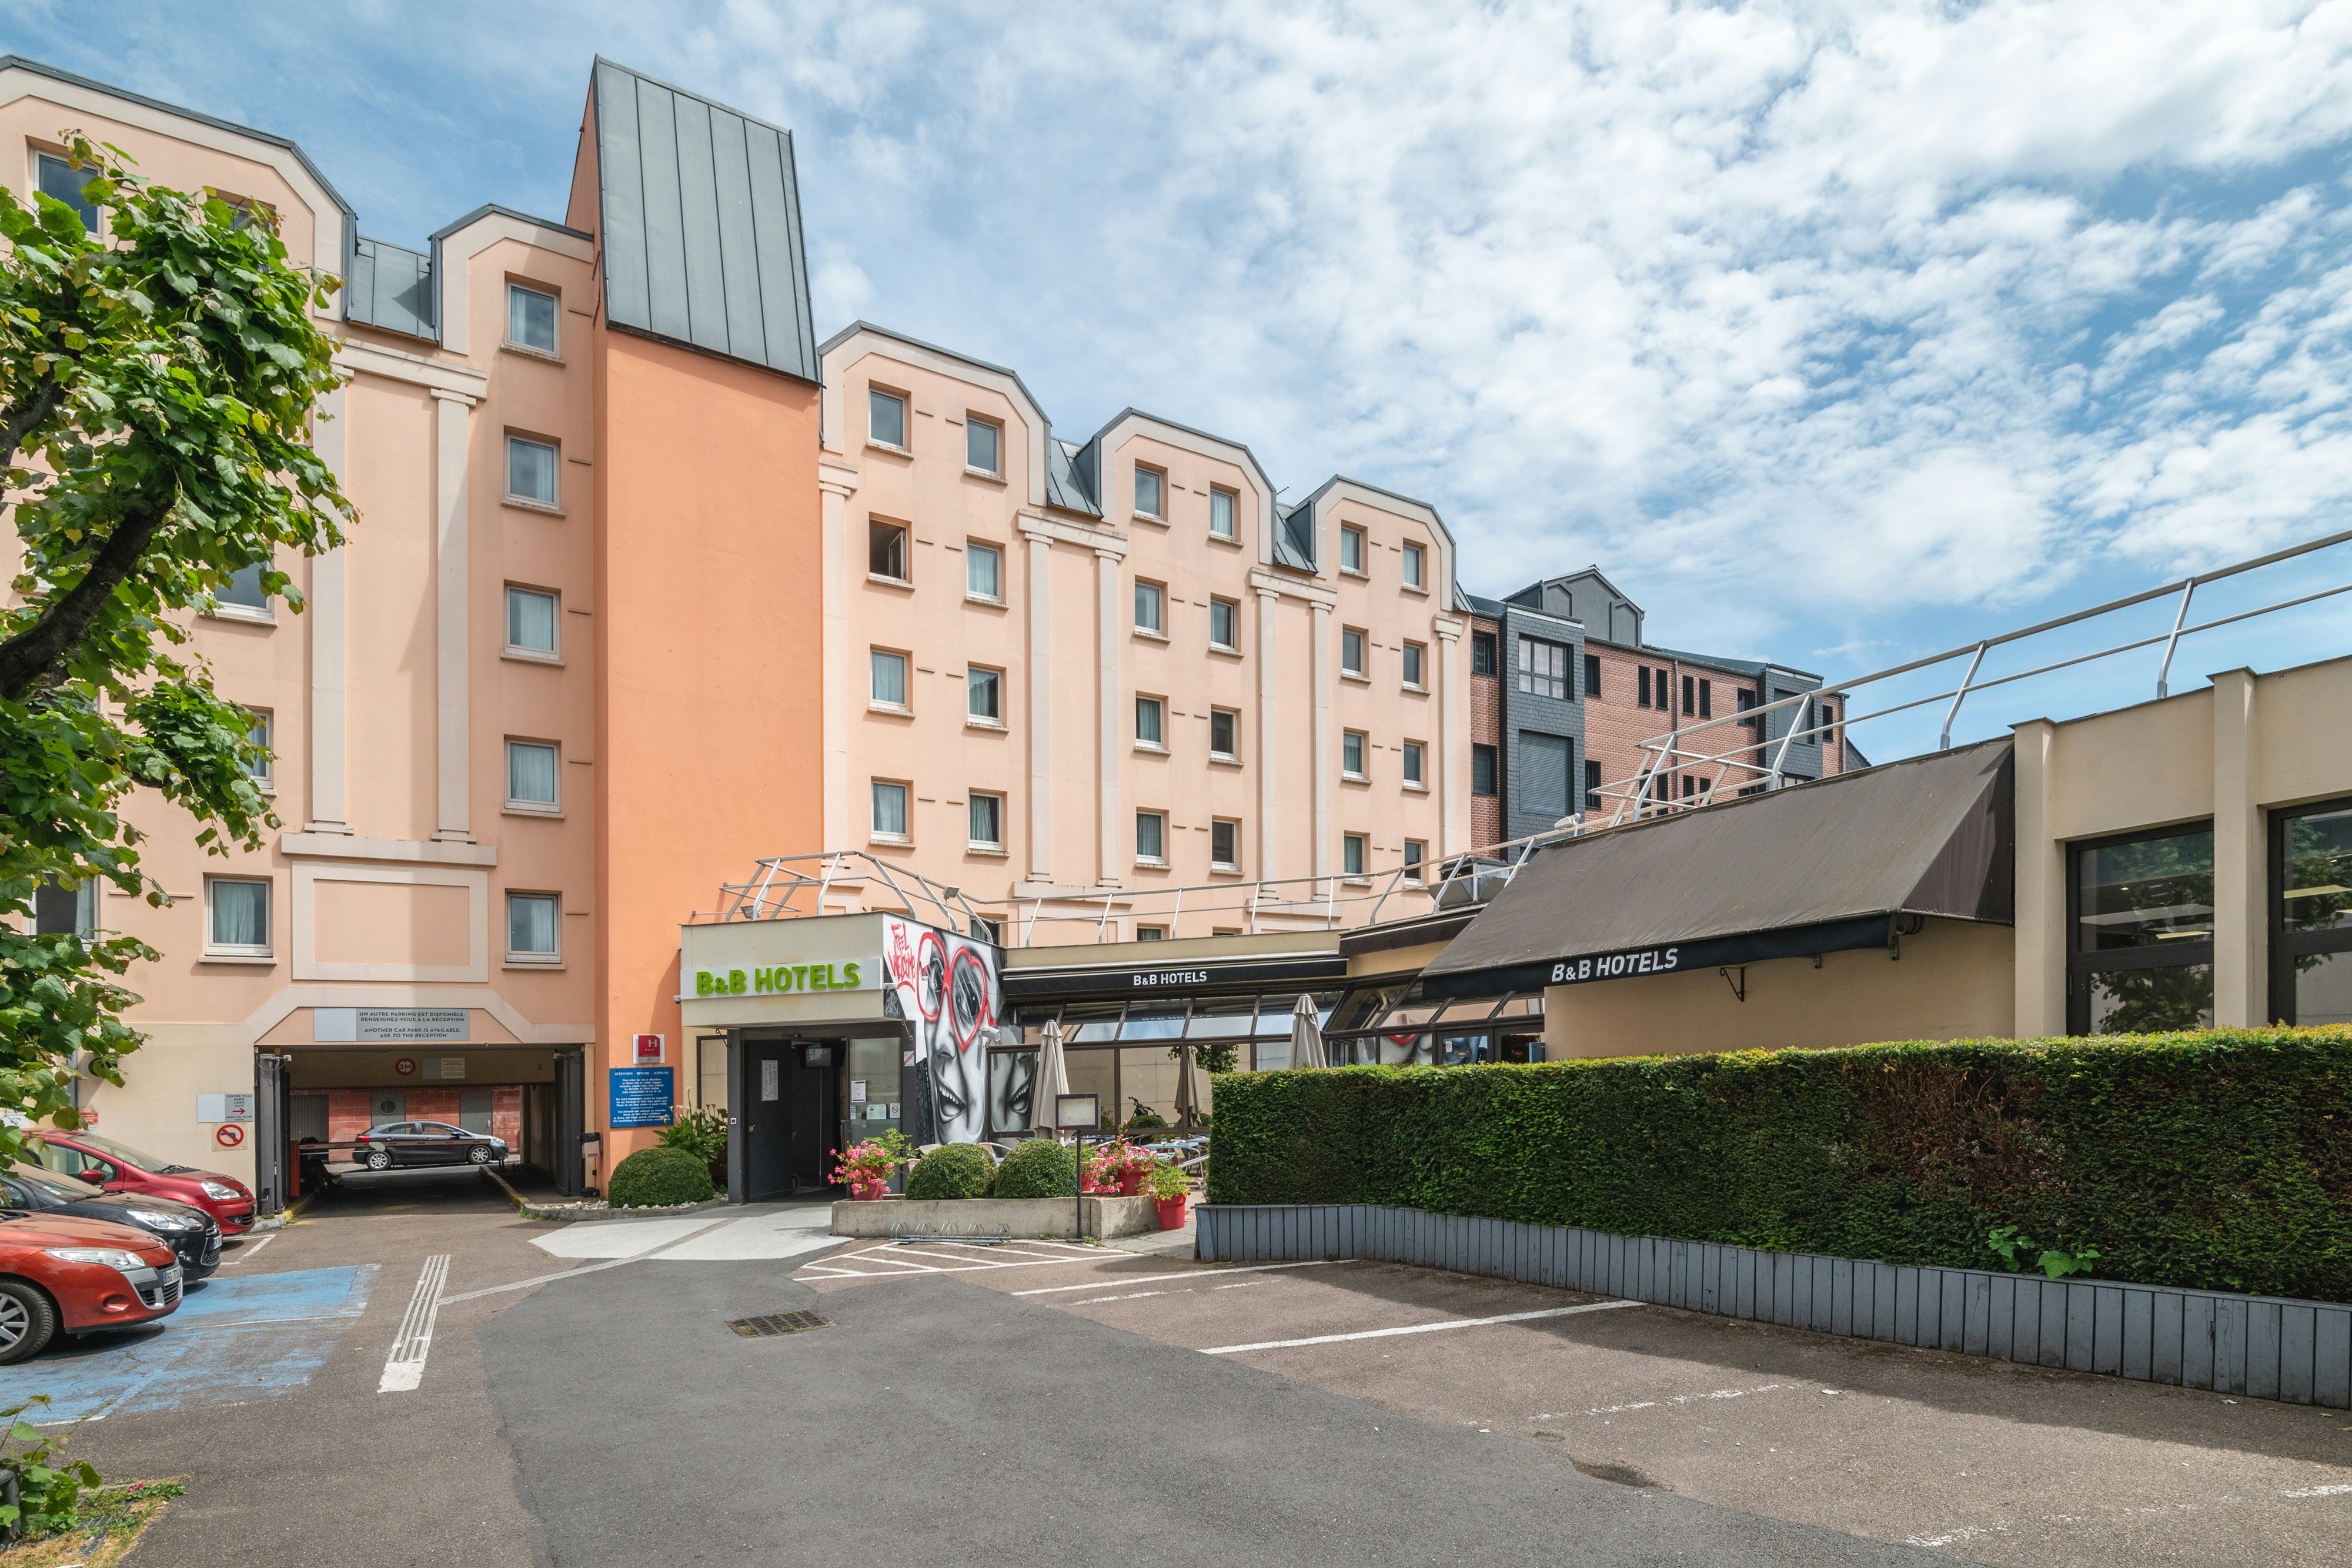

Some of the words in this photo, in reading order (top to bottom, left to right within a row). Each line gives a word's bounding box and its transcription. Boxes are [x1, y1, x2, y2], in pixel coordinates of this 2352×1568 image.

[891, 921, 910, 951] FEEL
[696, 969, 747, 995] B&B
[755, 962, 861, 992] HOTELS
[1134, 975, 1157, 985] B&B
[1161, 971, 1207, 984] HOTELS
[1552, 959, 1591, 982] B&B
[1596, 948, 1678, 977] HOTELS
